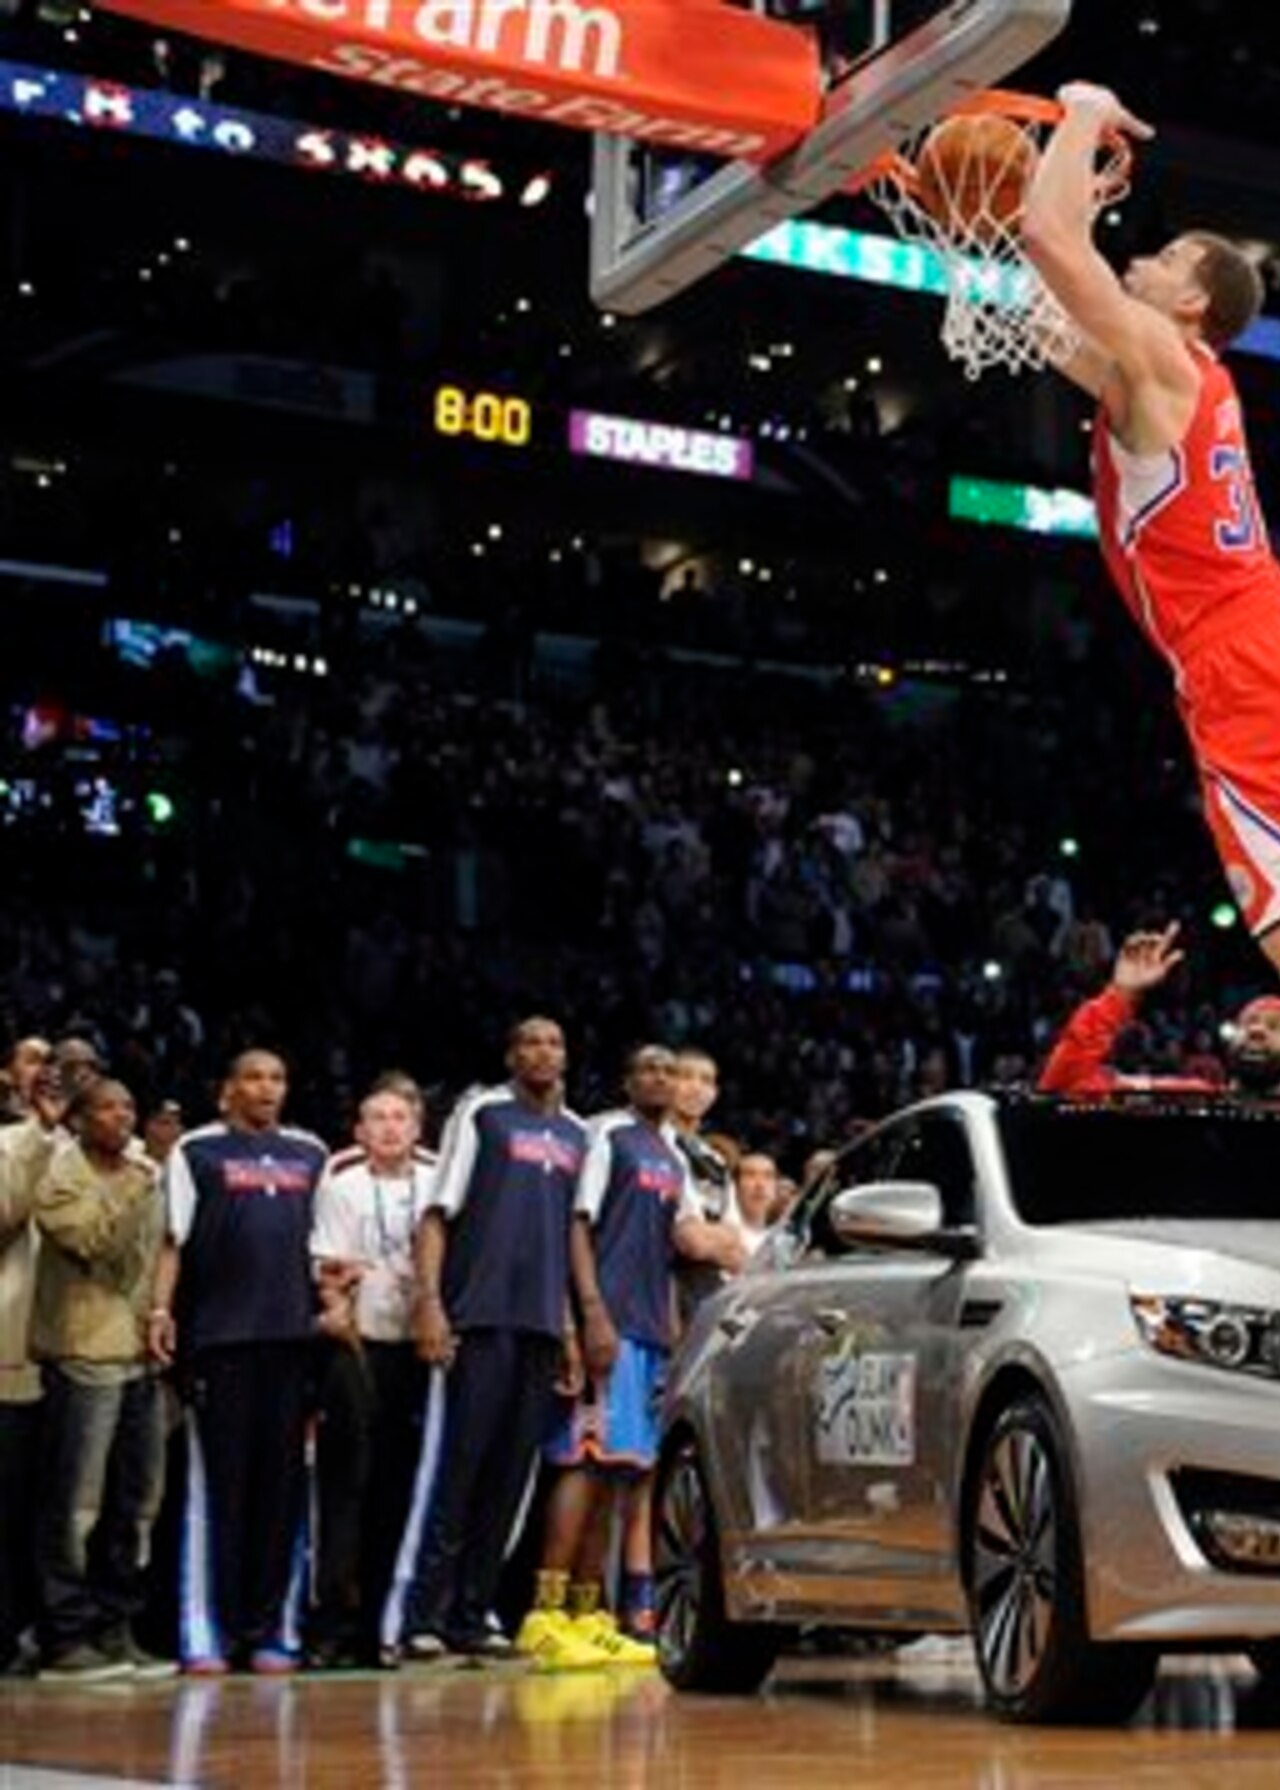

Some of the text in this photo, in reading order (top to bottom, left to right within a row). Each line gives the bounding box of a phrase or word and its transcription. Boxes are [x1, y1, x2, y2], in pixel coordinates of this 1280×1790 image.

[313, 45, 766, 156] State Farm
[434, 387, 531, 446] 8:00
[584, 413, 738, 477] STAPLES
